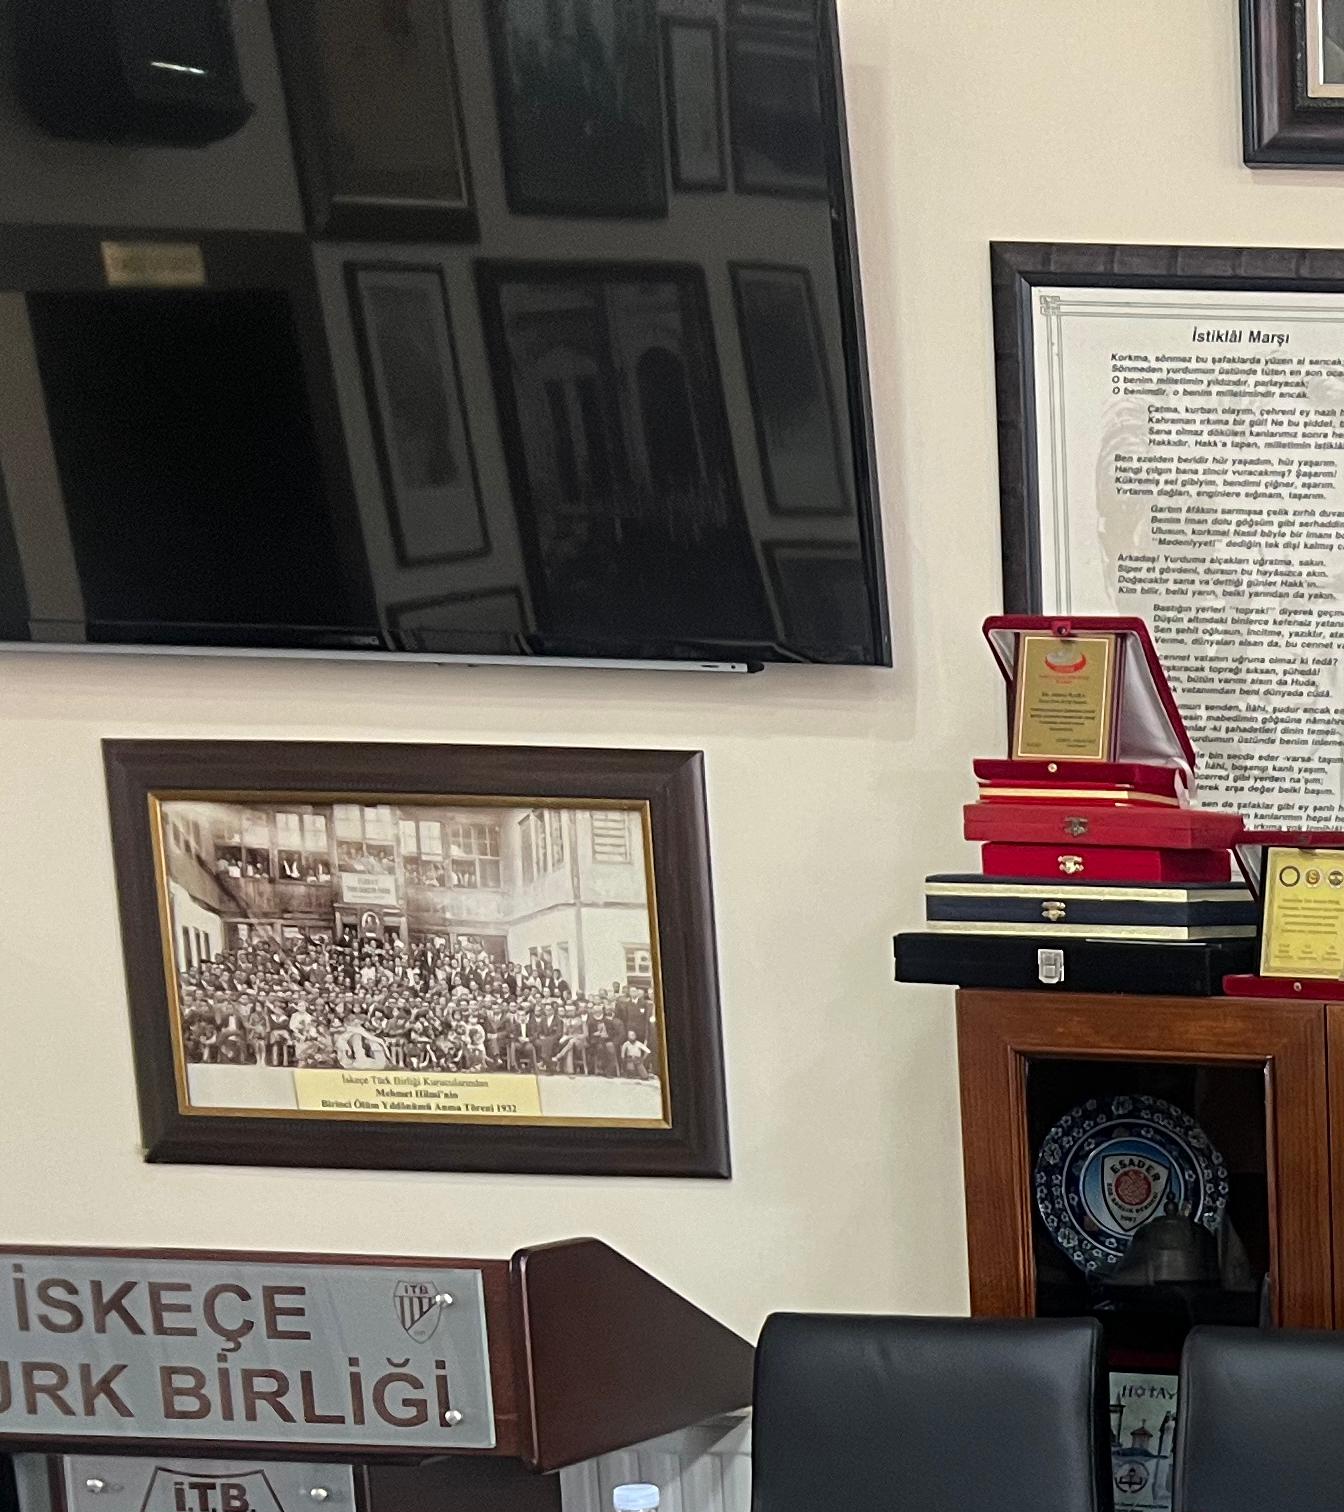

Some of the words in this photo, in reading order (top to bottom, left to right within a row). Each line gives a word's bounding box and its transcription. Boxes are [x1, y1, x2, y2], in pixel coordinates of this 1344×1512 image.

[1192, 326, 1243, 344] İstiklâl
[1248, 329, 1290, 347] Marşı
[1195, 355, 1208, 363] bu
[1111, 375, 1120, 384] O
[1112, 386, 1120, 395] O
[371, 1074, 391, 1085] Türk
[496, 1103, 517, 1113] 1932
[1110, 1158, 1161, 1182] ESADER
[11, 1263, 312, 1353] İSKEÇE
[0, 1359, 135, 1418] RK
[159, 1352, 454, 1429] BİRLİĞİ
